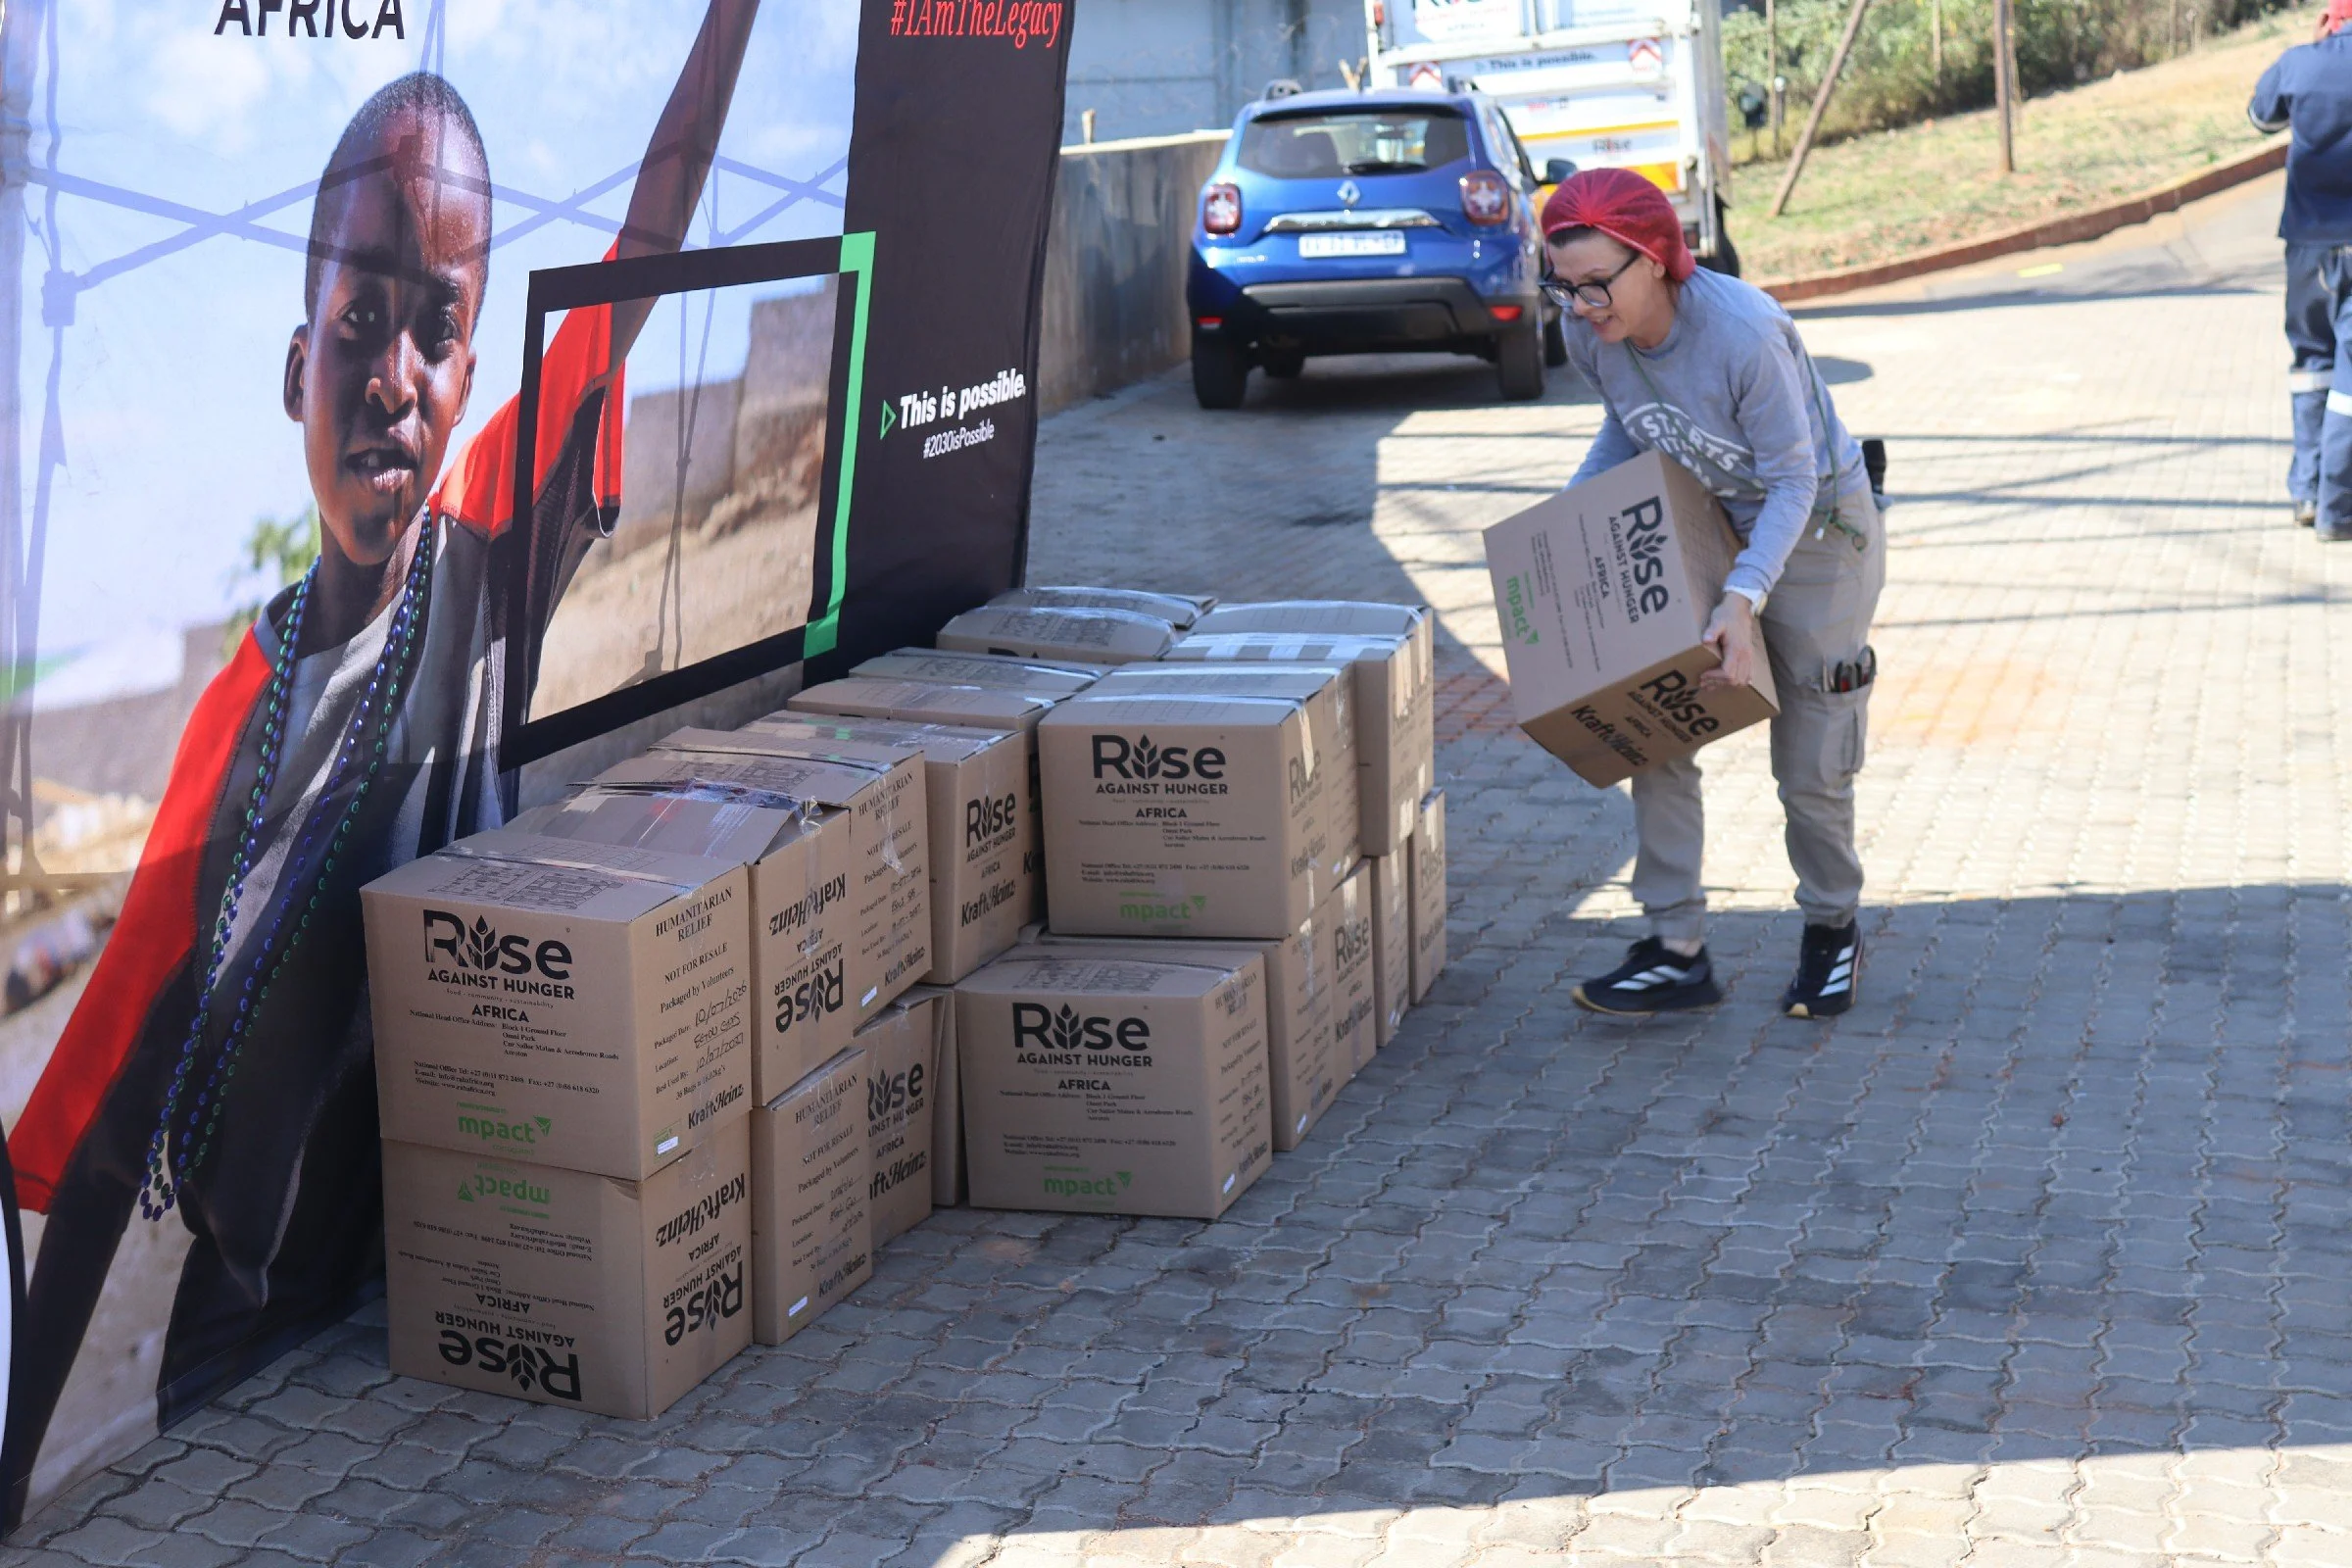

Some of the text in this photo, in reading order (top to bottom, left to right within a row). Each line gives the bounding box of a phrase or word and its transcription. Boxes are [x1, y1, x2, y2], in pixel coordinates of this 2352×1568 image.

[214, 0, 405, 40] AFRICA
[891, 0, 1063, 49] #IAmTheLegacy
[900, 368, 1026, 429] This is possible.
[923, 417, 995, 459] #2030isPossible
[1607, 515, 1640, 624] AGAINST HUNGER
[1622, 495, 1670, 614] Rise
[1593, 555, 1609, 599] AFRICA
[1641, 668, 1720, 738] Rise
[1091, 732, 1227, 780] Rise
[1095, 782, 1228, 796] AGAINST HUNGER
[966, 792, 1016, 849] Rise
[1135, 806, 1187, 819] AFRICA
[966, 838, 993, 863] AGAINST
[655, 884, 732, 938] HUMANITARIAN
[768, 873, 846, 936] KraftHeinz
[1119, 900, 1191, 923] mpact
[423, 909, 572, 980] Rise
[677, 911, 712, 943] RELIEF
[663, 940, 728, 985] NOT FOR RESALE
[809, 940, 842, 974] AGAINST
[426, 966, 575, 1001] AGAINST HUNGER
[446, 987, 555, 1009] food community sustainability
[660, 963, 734, 1015] Packaged by Volunteers
[773, 961, 808, 999] HUNGER
[775, 958, 844, 1033] Rise
[470, 1003, 529, 1023] AFRICA
[501, 1021, 519, 1032] Block
[524, 1025, 549, 1036] Ground
[1011, 1001, 1152, 1053] Rise
[519, 1033, 536, 1042] Park
[654, 1052, 679, 1074] Location:
[1015, 1052, 1152, 1068] AGAINST HUNGER
[687, 1077, 744, 1131] KraftHeinz
[795, 1070, 858, 1125] HUMANITARIAN
[1056, 1078, 1111, 1092] AFRICA
[456, 1111, 536, 1148] mpact
[473, 1170, 550, 1207] mpact
[1042, 1173, 1117, 1200] mpact
[655, 1173, 746, 1248] KraftHeinz
[687, 1230, 720, 1265] AFRICA
[705, 1243, 742, 1282] AGAINST
[474, 1292, 530, 1314] AFRICA
[662, 1270, 702, 1311] HUNGER
[664, 1260, 743, 1347] Rise
[433, 1309, 575, 1349] AGAINST HUNGER
[439, 1329, 582, 1401] Rise
